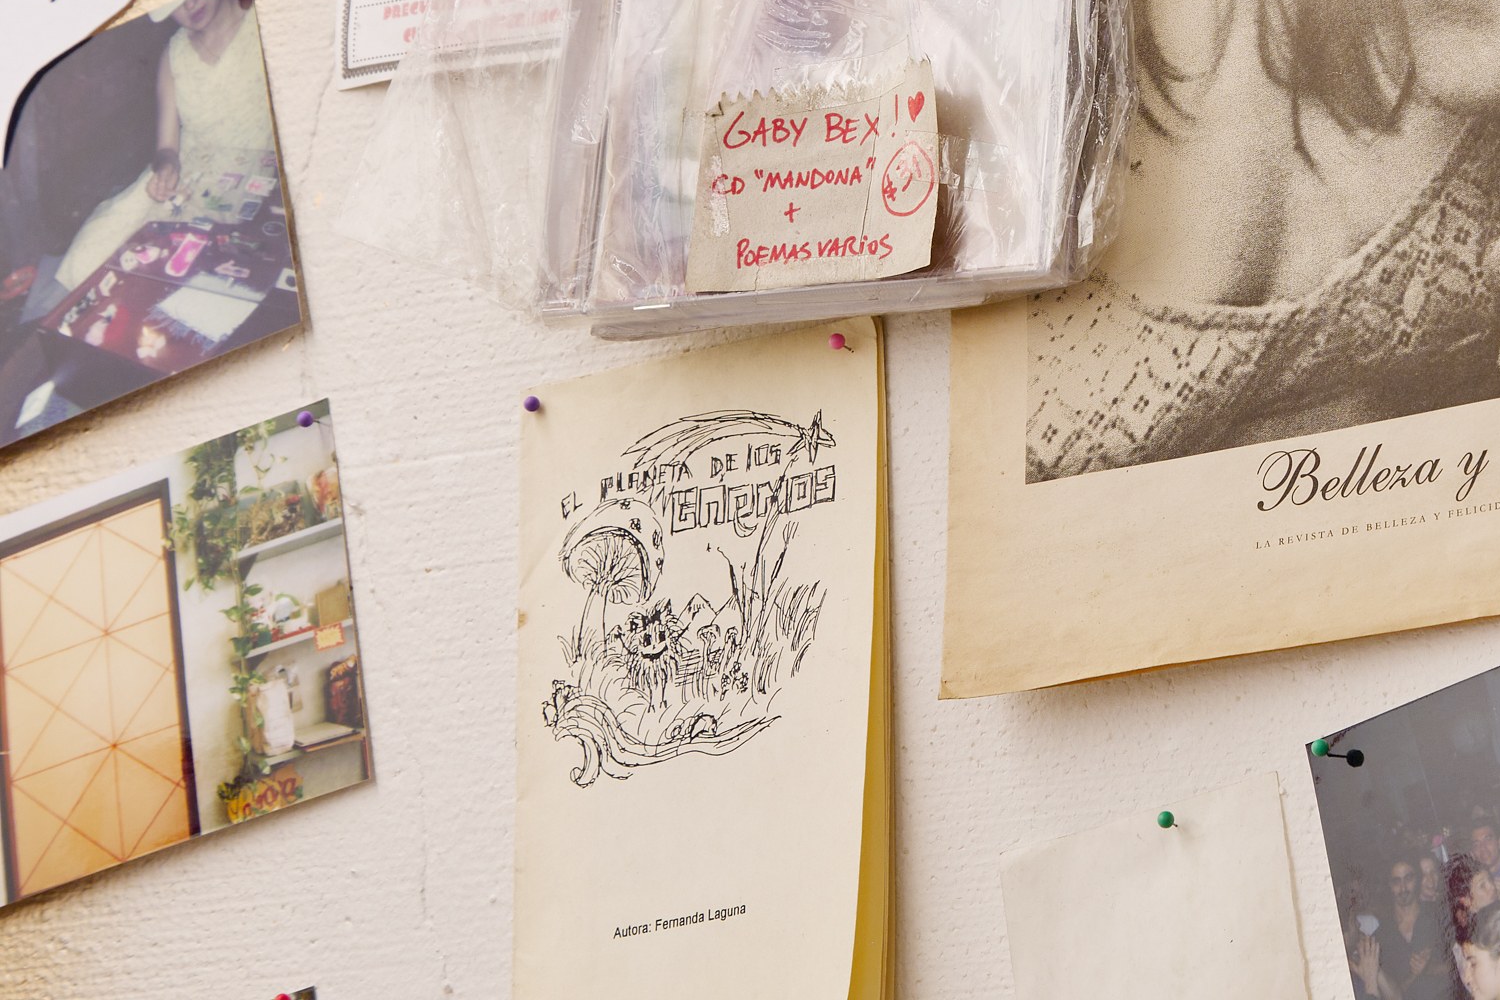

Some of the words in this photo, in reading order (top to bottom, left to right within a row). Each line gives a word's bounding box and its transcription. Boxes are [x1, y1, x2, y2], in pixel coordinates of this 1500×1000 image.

[723, 111, 808, 149] GABY
[712, 174, 745, 195] CD
[736, 238, 812, 269] POEMAS
[1256, 444, 1443, 513] Belleza
[1455, 446, 1489, 500] y
[1255, 539, 1272, 550] LA
[1278, 528, 1336, 546] REVISTA
[1341, 523, 1361, 537] DE
[1366, 513, 1429, 533] BELLEZA
[1433, 511, 1442, 522] Y
[613, 923, 652, 939] Autora:
[655, 911, 705, 931] Fernanda
[708, 904, 746, 921] Laguna
